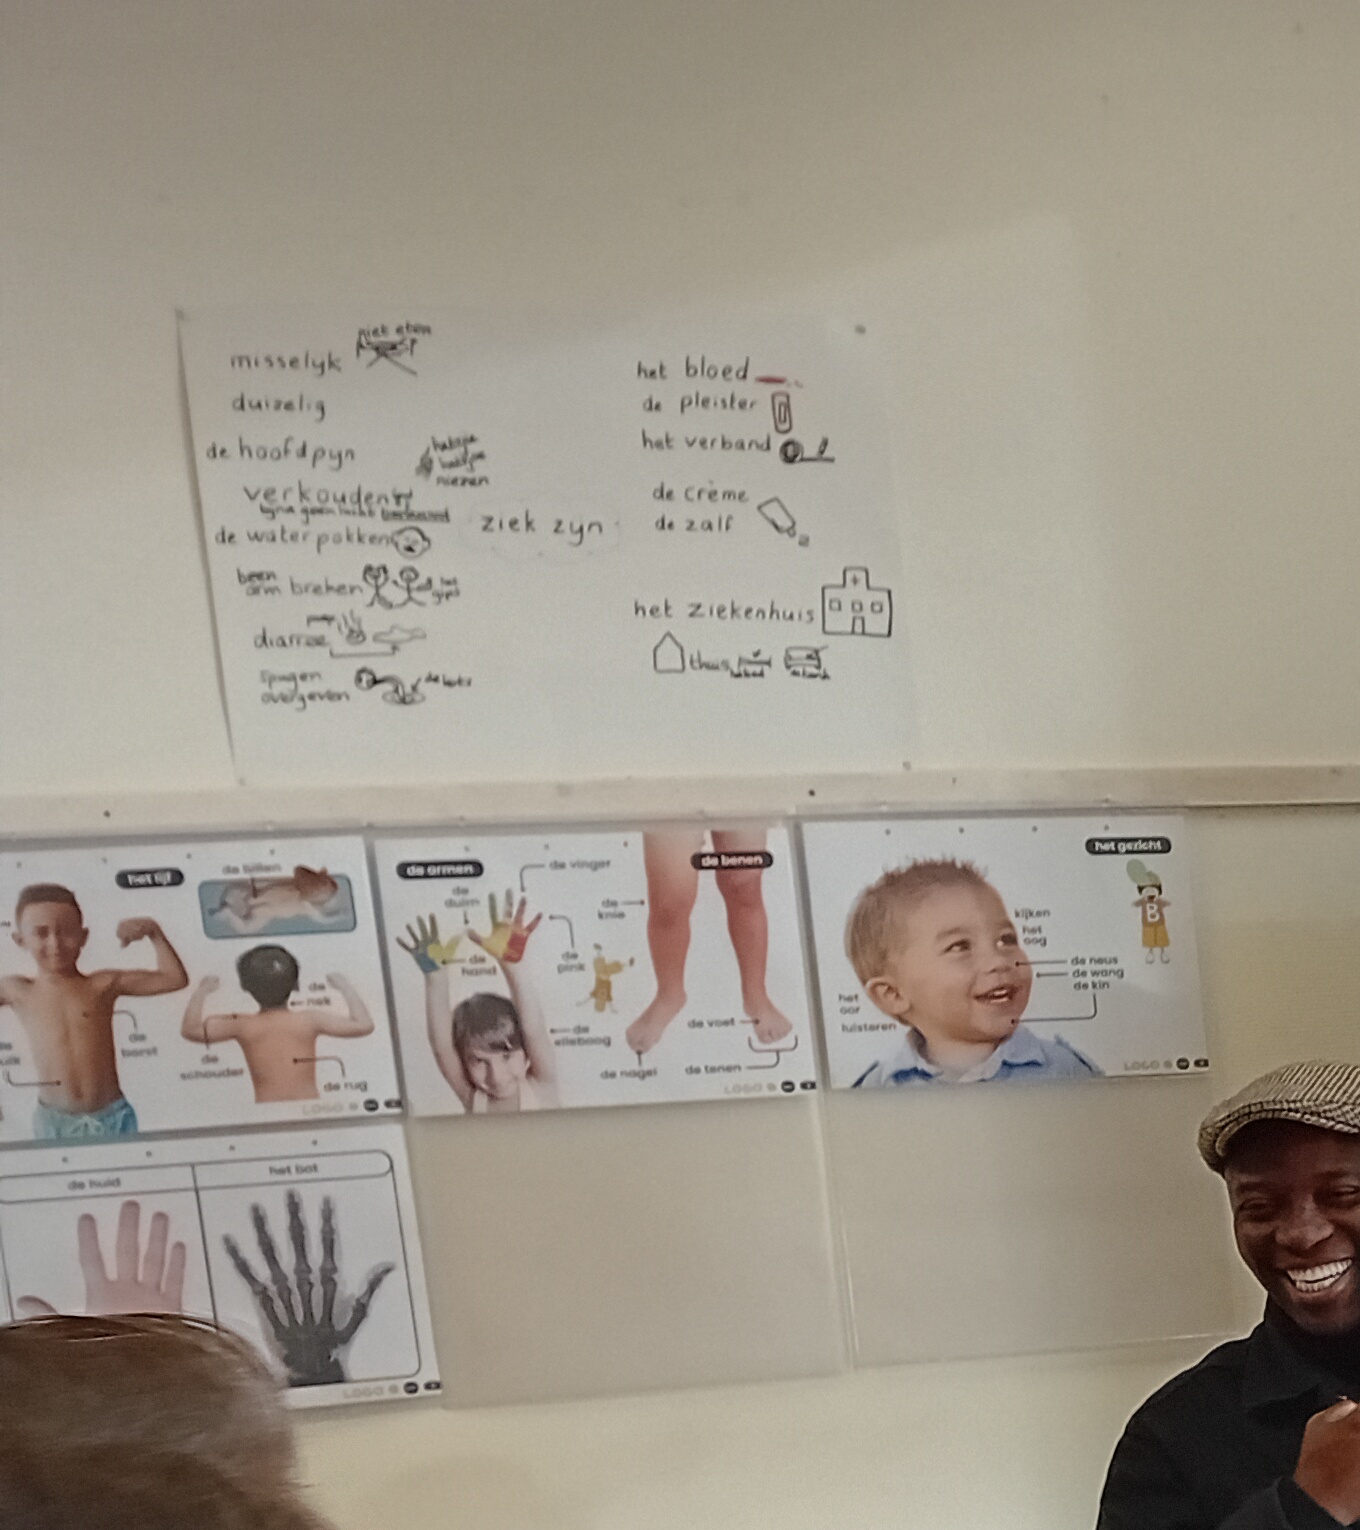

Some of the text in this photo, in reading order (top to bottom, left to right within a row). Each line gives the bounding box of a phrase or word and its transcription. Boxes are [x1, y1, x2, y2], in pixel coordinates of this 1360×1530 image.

[636, 356, 750, 380] het bloed
[231, 393, 326, 421] duizelig
[642, 391, 758, 414] de pleister
[641, 429, 772, 451] het verband
[205, 441, 229, 459] de
[243, 479, 394, 506] verkouden
[653, 480, 750, 501] de crème
[481, 508, 536, 533] ziek
[655, 514, 735, 531] de zalf
[215, 526, 237, 545] de
[237, 568, 277, 584] been
[290, 577, 363, 597] breken
[634, 599, 815, 622] het ziekenhuis
[1095, 839, 1162, 854] het gezicht
[549, 857, 611, 872] de vinger
[701, 854, 763, 867] de benen
[406, 864, 474, 877] de armen
[1014, 908, 1050, 920] kijken
[1147, 904, 1159, 922] B
[1023, 925, 1043, 936] het
[1024, 936, 1047, 947] oog
[1071, 956, 1118, 966] de neus
[1072, 967, 1124, 981] de wang
[1073, 980, 1110, 990] de kin
[838, 993, 859, 1004] het
[841, 1022, 897, 1033] luisteren
